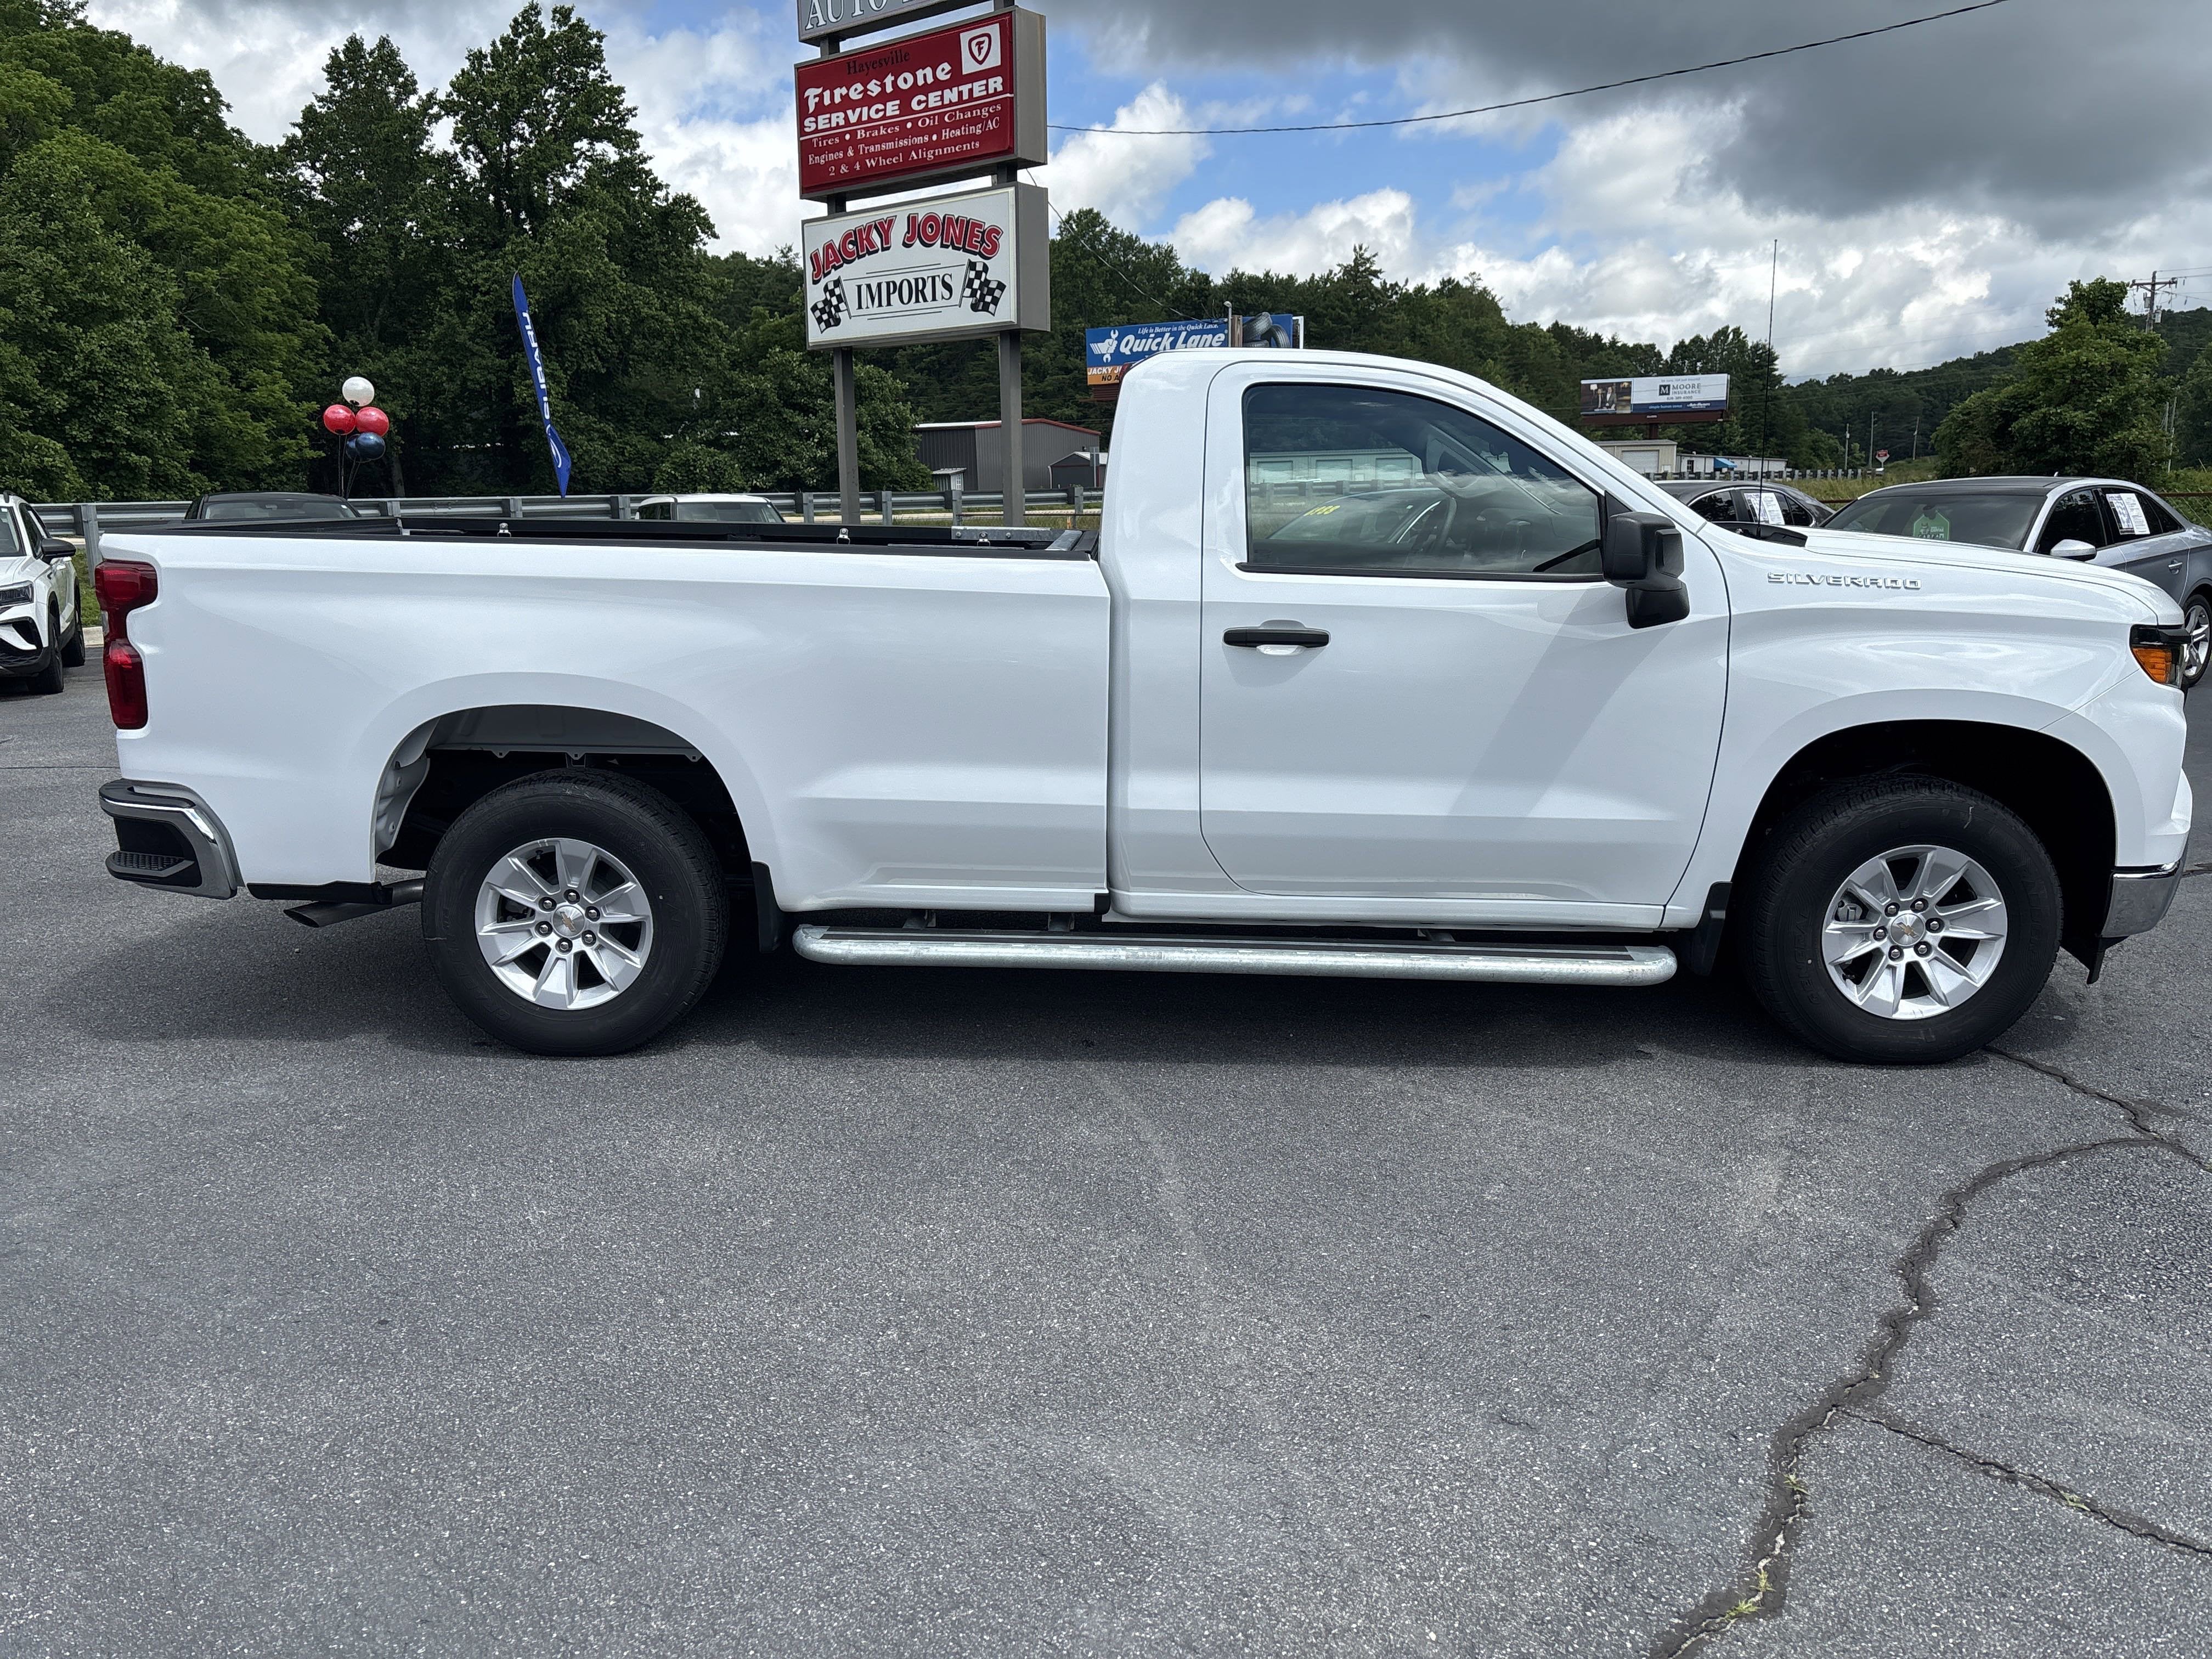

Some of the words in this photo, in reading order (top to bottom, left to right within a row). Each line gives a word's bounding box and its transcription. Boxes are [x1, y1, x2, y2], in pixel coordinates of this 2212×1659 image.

[847, 49, 910, 76] Hayesville
[803, 100, 900, 133] SERVICE
[911, 76, 1003, 110] CENTER
[804, 61, 952, 114] Firestone
[808, 148, 843, 166] Engines
[847, 146, 854, 157] &
[857, 133, 929, 156] Transmissions
[941, 116, 1000, 141] Heating/AC
[812, 135, 839, 148] Tires
[856, 125, 900, 140] Brakes
[918, 117, 939, 128] Oil
[944, 103, 1002, 123] Changes
[828, 166, 836, 177] 2
[839, 164, 849, 174] &
[854, 162, 861, 172] 4
[866, 153, 903, 169] Wheel
[909, 139, 980, 161] Alignments
[810, 215, 897, 285] JACKY
[902, 212, 1004, 261] JONES
[855, 273, 953, 311] IMPORTS
[1120, 332, 1175, 355] Quick
[1175, 331, 1225, 349] Lane
[522, 311, 550, 420] SUBARU
[1088, 367, 1111, 375] JACKY
[1660, 386, 1669, 394] M
[1768, 572, 1921, 589] SILVERADO
